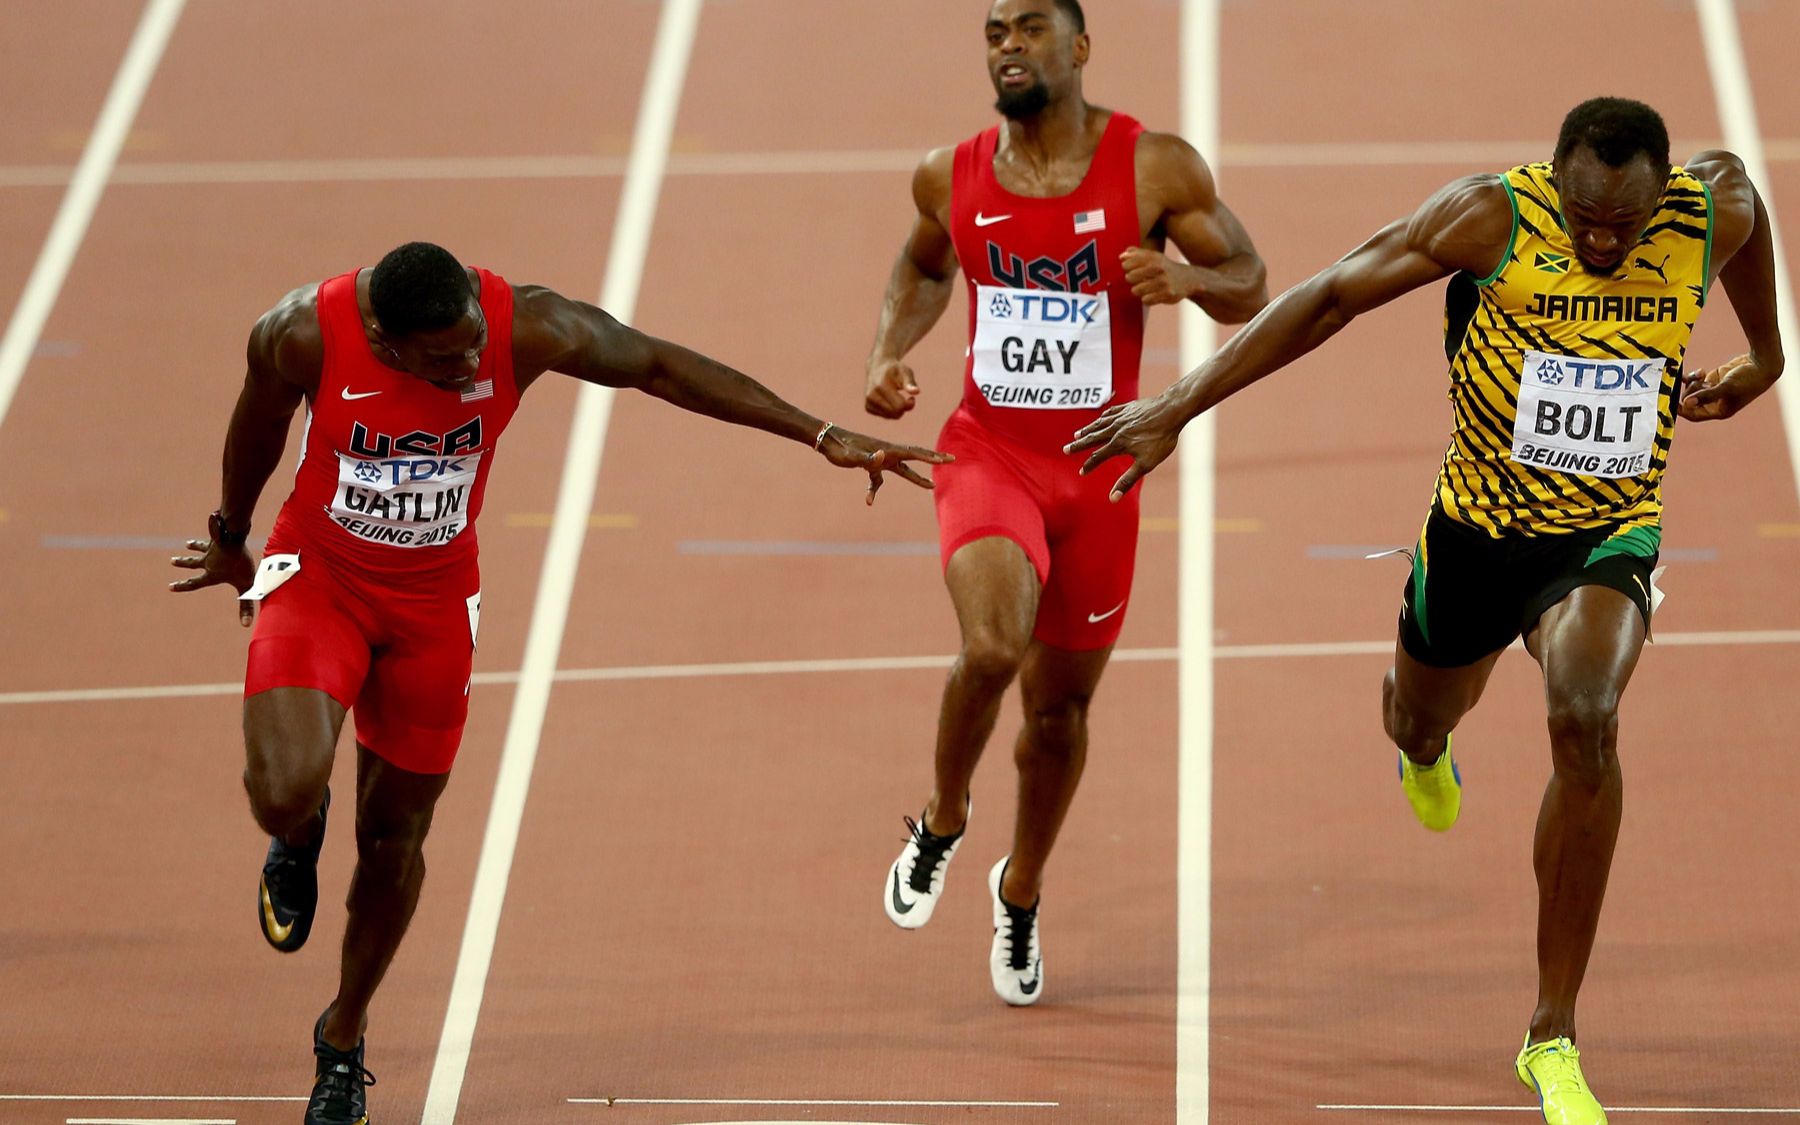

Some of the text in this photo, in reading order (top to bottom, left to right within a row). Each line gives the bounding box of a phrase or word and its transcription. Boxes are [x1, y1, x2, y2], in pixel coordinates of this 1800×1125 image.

[987, 239, 1100, 293] USA
[1013, 295, 1097, 323] TDK
[1526, 294, 1678, 322] JAMAICA
[1001, 336, 1080, 375] GAY
[1565, 362, 1653, 391] TDK
[981, 384, 1102, 405] BEIJING 2015
[350, 415, 482, 458] USA
[1534, 400, 1642, 443] BOLT
[381, 457, 468, 486] TDK
[1518, 444, 1646, 475] BEIJING 2015
[344, 484, 465, 523] GATLIN
[336, 515, 459, 546] BEIJING 2015
